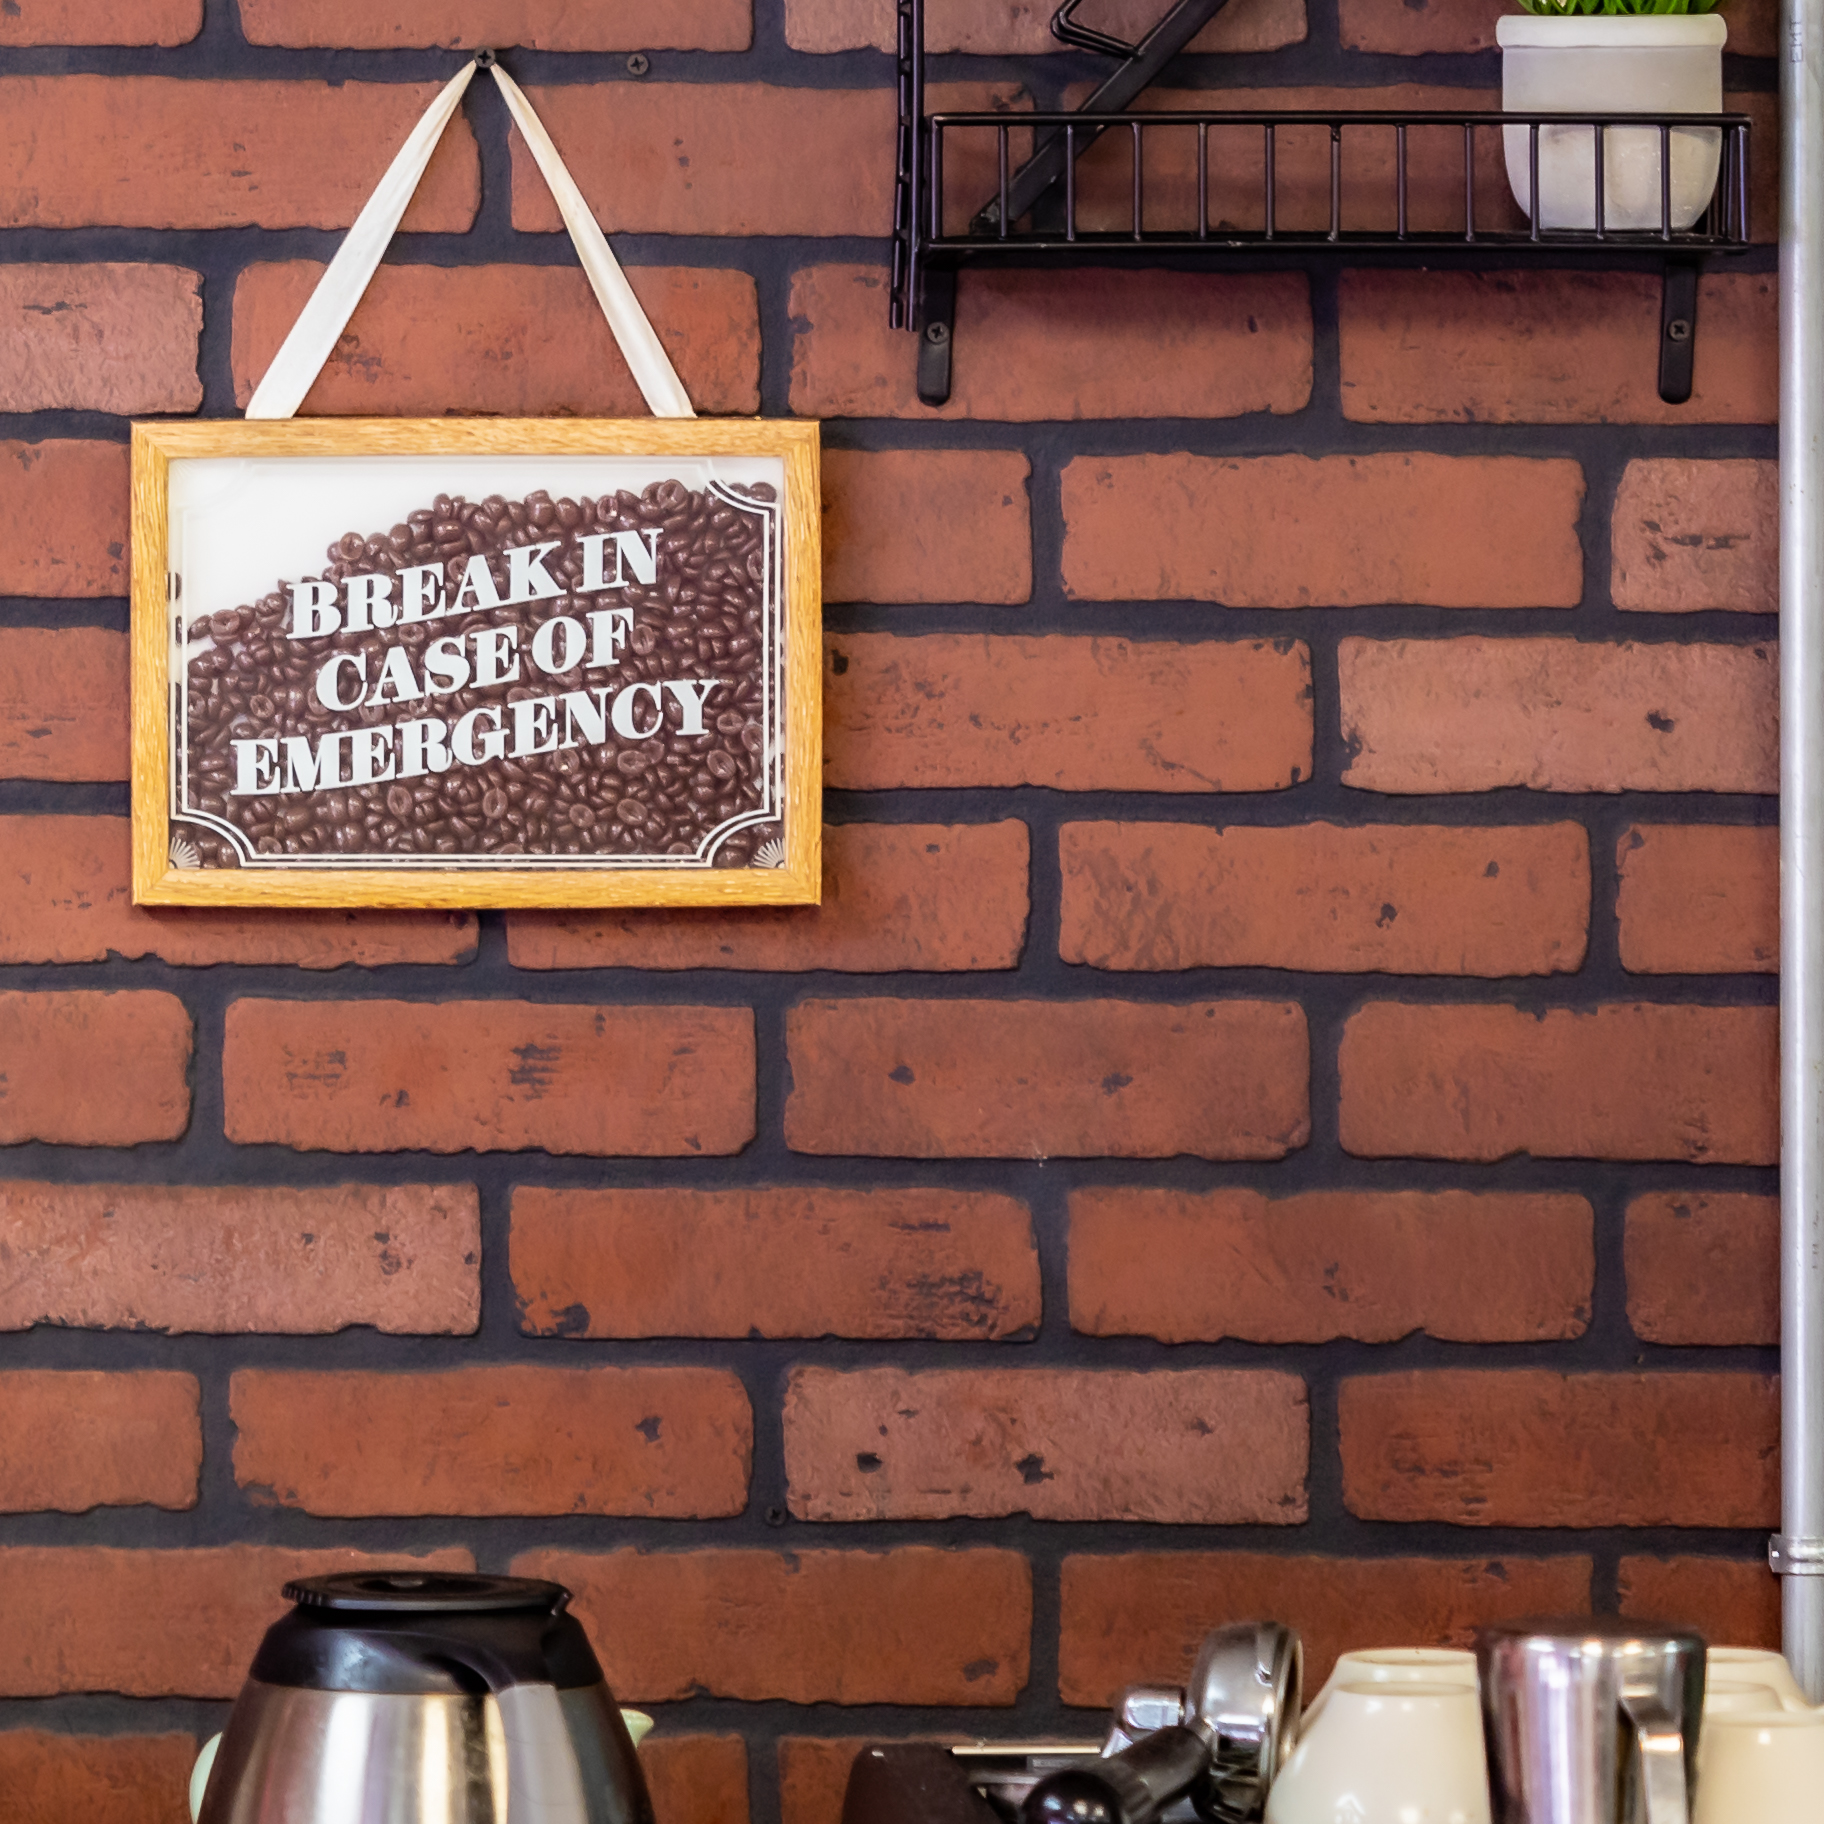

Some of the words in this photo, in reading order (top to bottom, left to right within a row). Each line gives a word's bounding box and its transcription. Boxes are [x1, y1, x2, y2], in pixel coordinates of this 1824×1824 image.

[286, 540, 568, 640] BREAK
[575, 527, 664, 593] IN
[315, 624, 521, 712] CASE
[530, 607, 634, 675] OF
[229, 679, 721, 796] EMERGENCY
